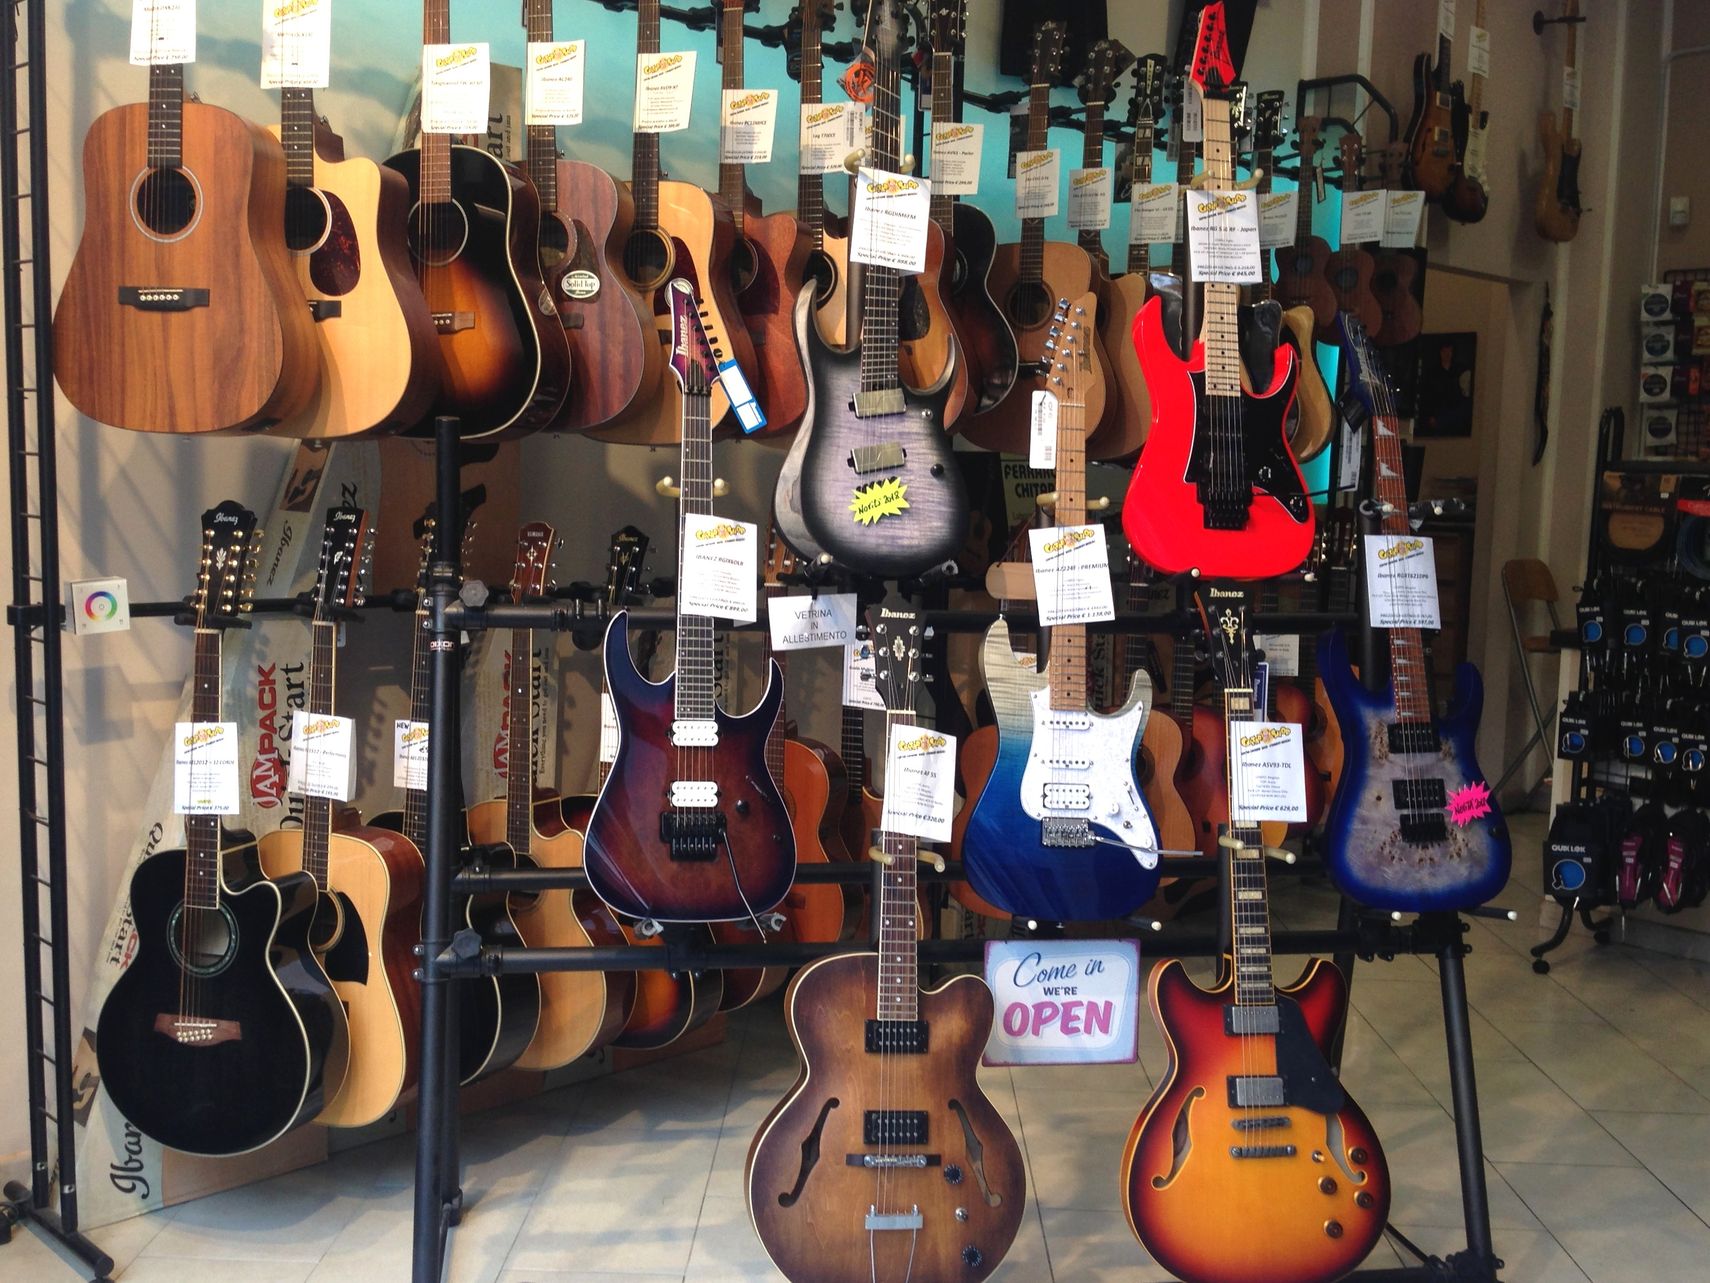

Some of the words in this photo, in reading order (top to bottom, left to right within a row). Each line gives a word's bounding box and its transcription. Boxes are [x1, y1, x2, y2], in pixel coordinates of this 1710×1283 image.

[214, 512, 239, 526] Ibanez
[333, 511, 357, 523] Ibanez
[1210, 588, 1244, 598] Ibanez
[794, 608, 832, 621] VETRINA
[880, 608, 917, 620] Ibanez
[810, 622, 819, 630] IN
[782, 630, 848, 645] ALLESTIMENTO
[1013, 952, 1078, 988] Come
[1084, 958, 1105, 976] in
[1043, 986, 1078, 996] WE'RE
[1003, 1000, 1114, 1037] OPEN
